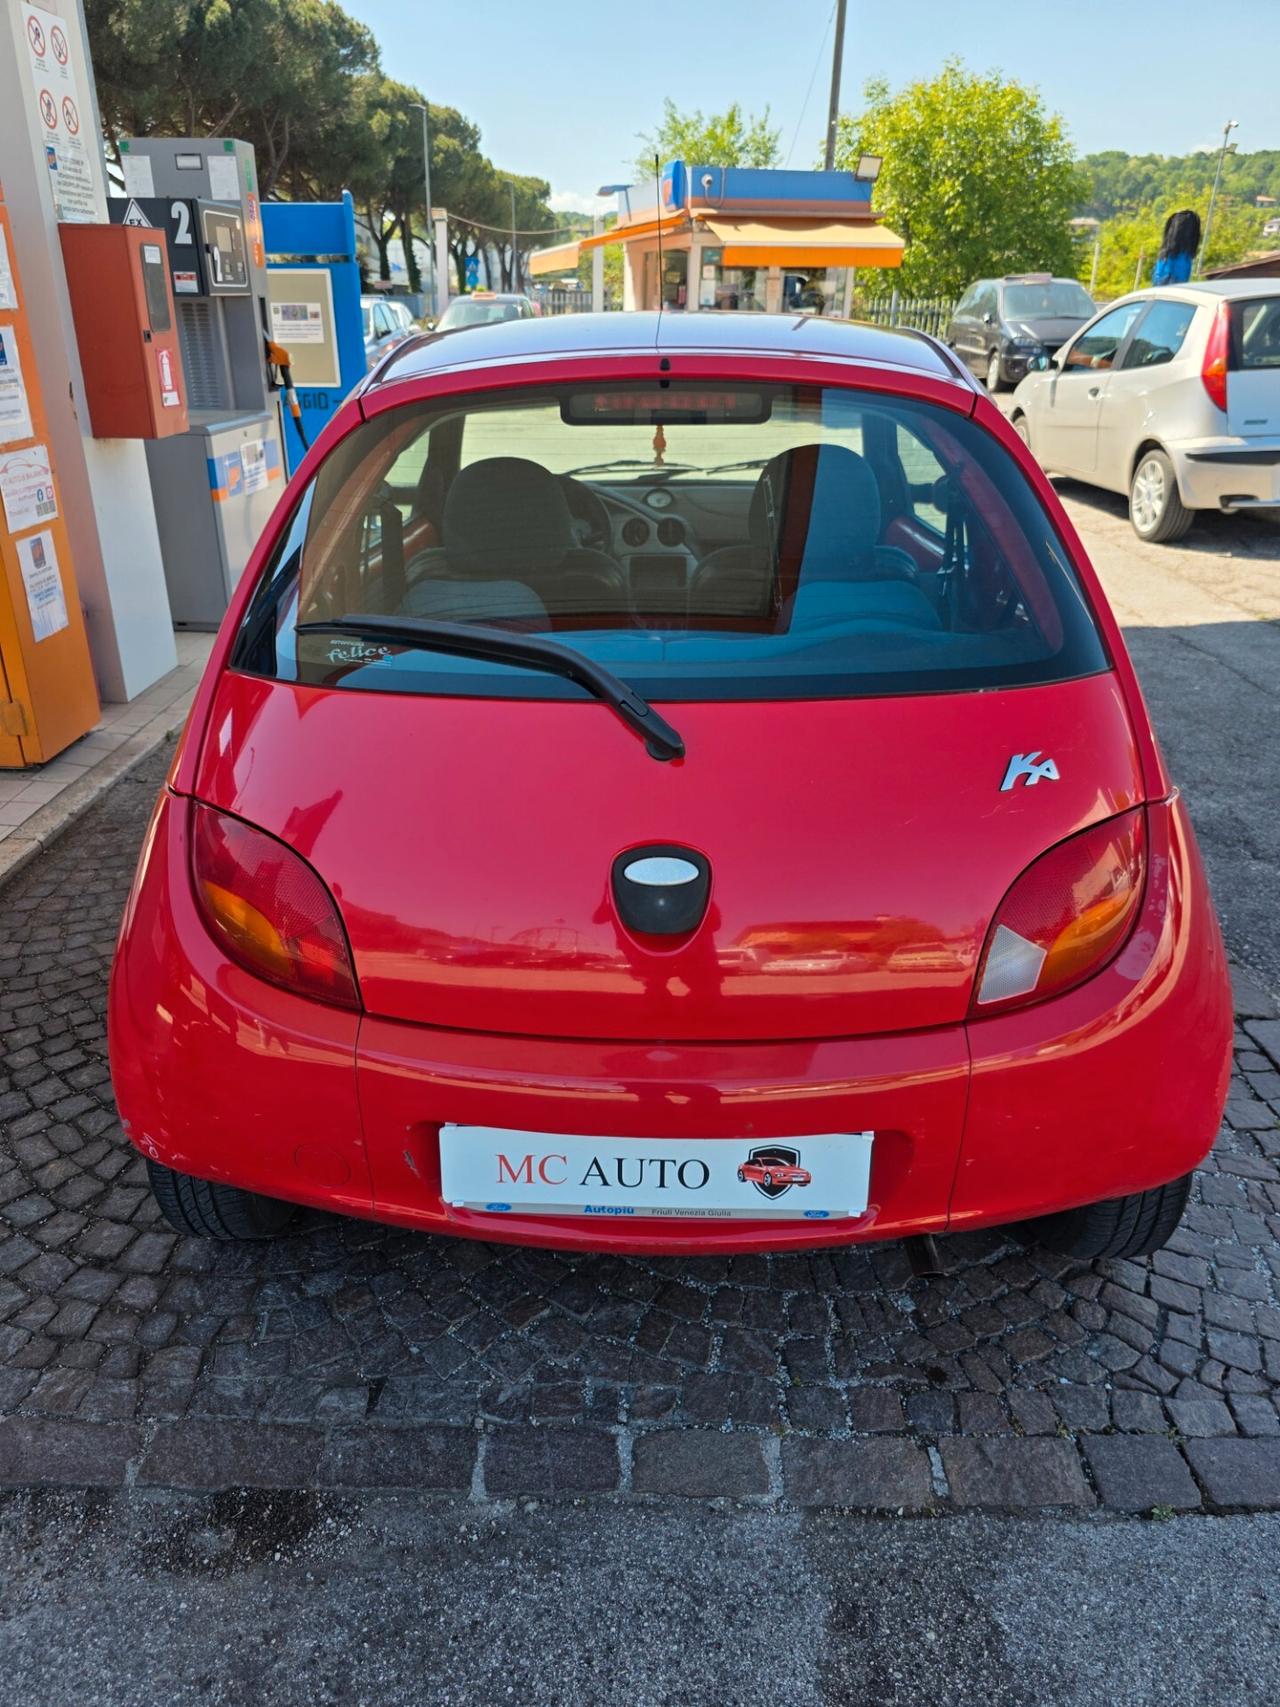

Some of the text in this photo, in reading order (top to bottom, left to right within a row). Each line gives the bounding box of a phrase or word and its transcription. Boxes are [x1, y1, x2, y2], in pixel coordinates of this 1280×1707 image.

[171, 201, 193, 245] 2
[495, 1154, 711, 1190] MC AUTO
[651, 1208, 732, 1217] Friuli Venezia Giulia
